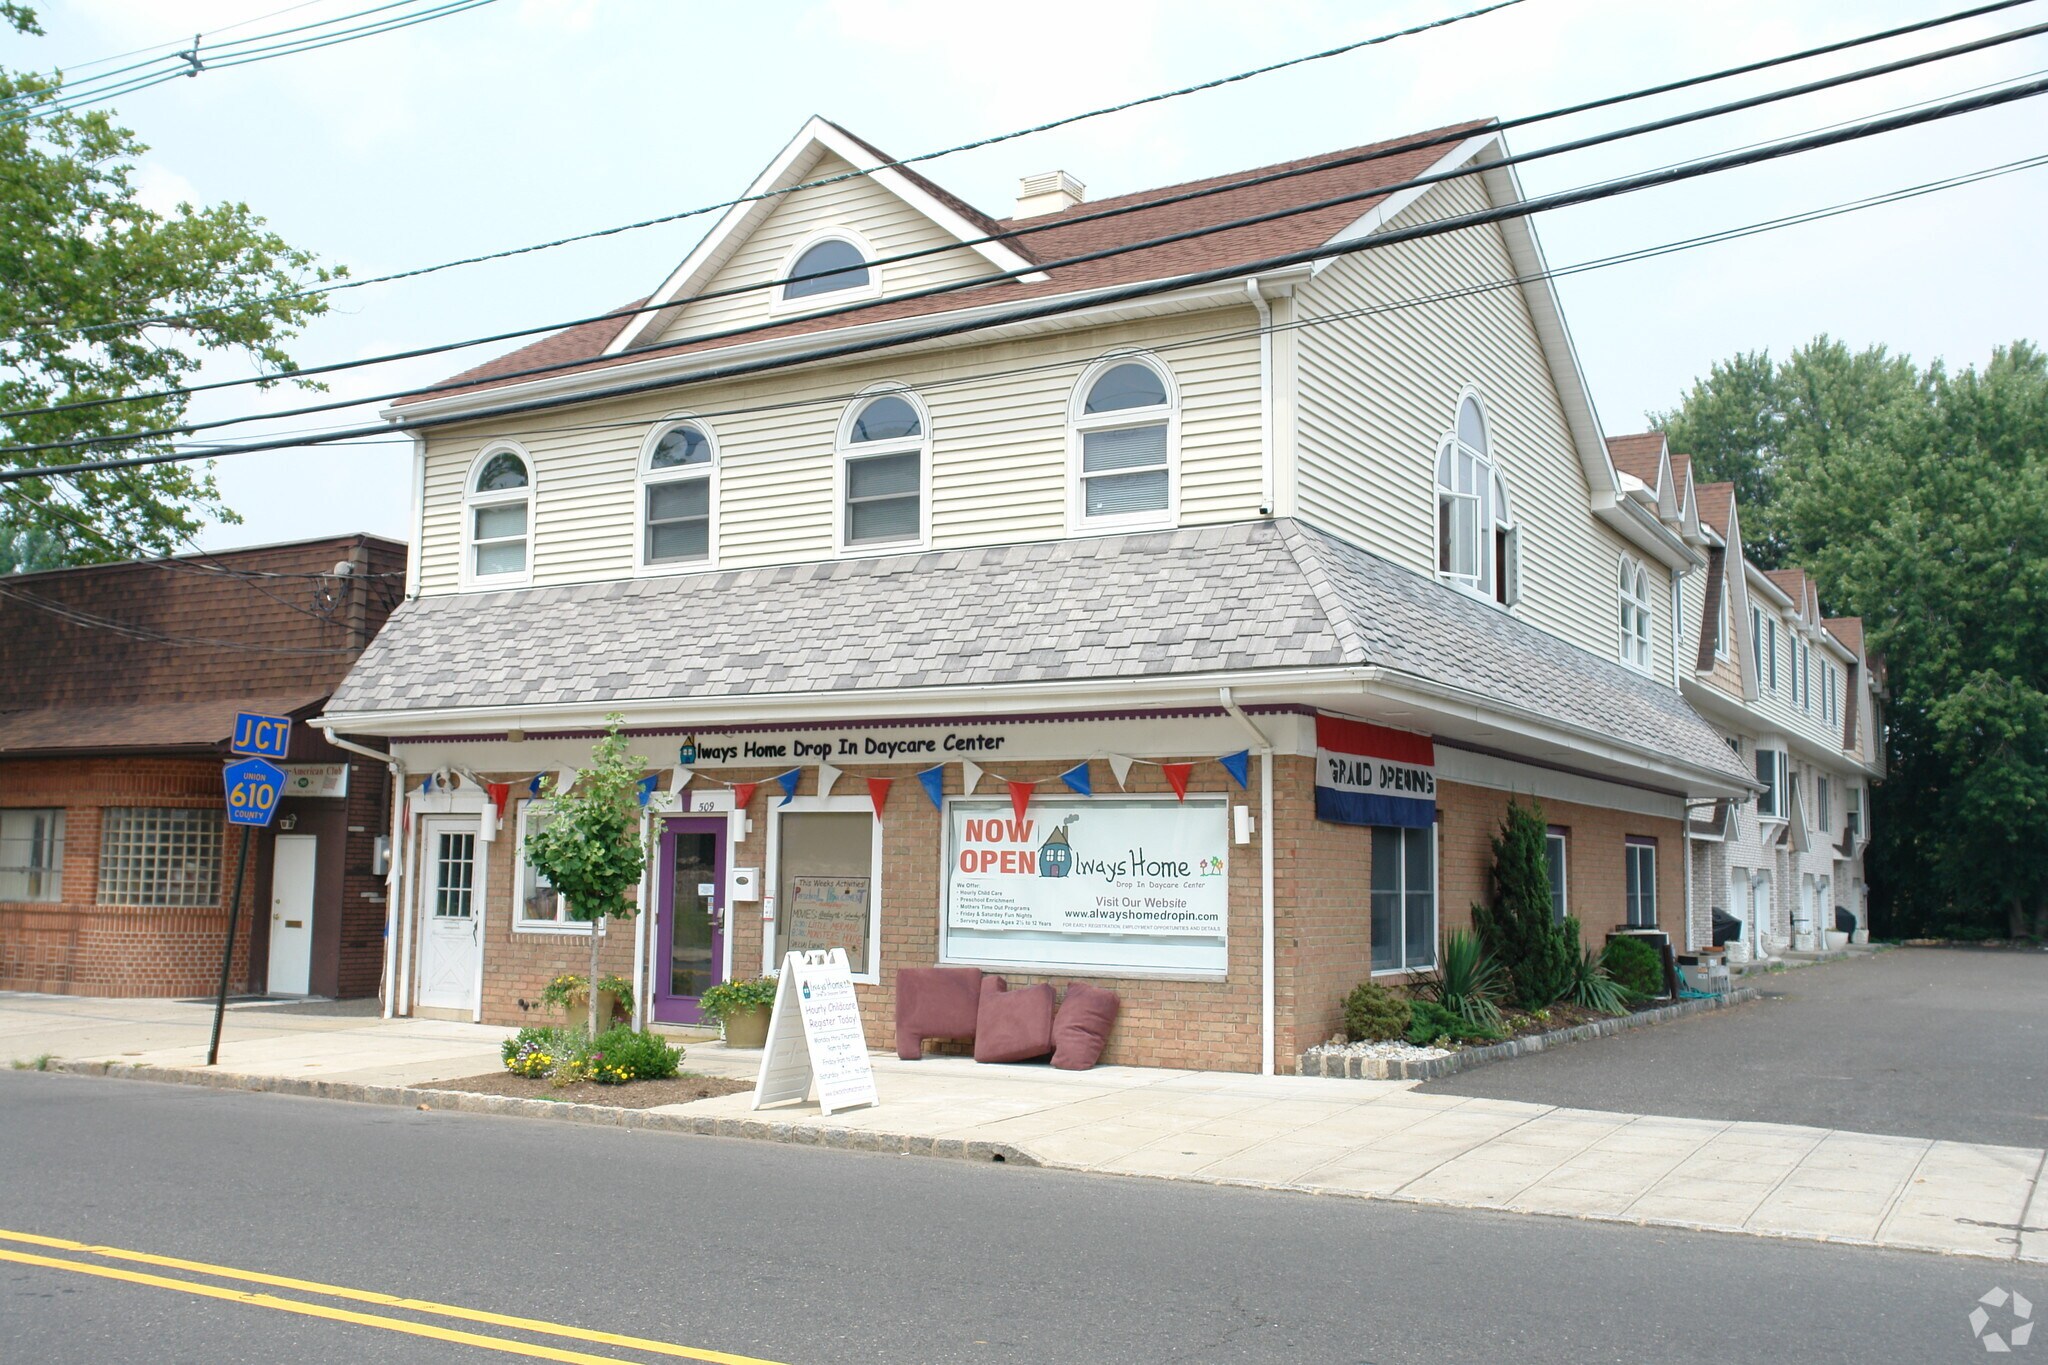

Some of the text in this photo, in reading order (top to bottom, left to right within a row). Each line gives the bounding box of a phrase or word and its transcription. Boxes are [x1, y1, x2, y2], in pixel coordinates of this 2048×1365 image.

[235, 719, 288, 751] JCT
[744, 741, 786, 758] Home
[793, 740, 832, 761] Drop
[838, 738, 858, 755] In
[865, 737, 936, 760] Daycare
[943, 734, 1005, 752] Center
[243, 772, 267, 782] UNION
[326, 766, 343, 776] Club
[229, 782, 274, 810] 610
[234, 809, 264, 819] COUNTY
[698, 801, 715, 812] 509
[965, 818, 1034, 843] NOW
[959, 849, 1036, 875] OPEN
[1128, 847, 1191, 878] Home
[1116, 881, 1133, 889] Drop
[1149, 881, 1179, 890] Daycare
[1183, 881, 1206, 889] Center
[1095, 896, 1187, 908] Visit Our Website
[1064, 908, 1219, 923] www.alwayshomedropin.com
